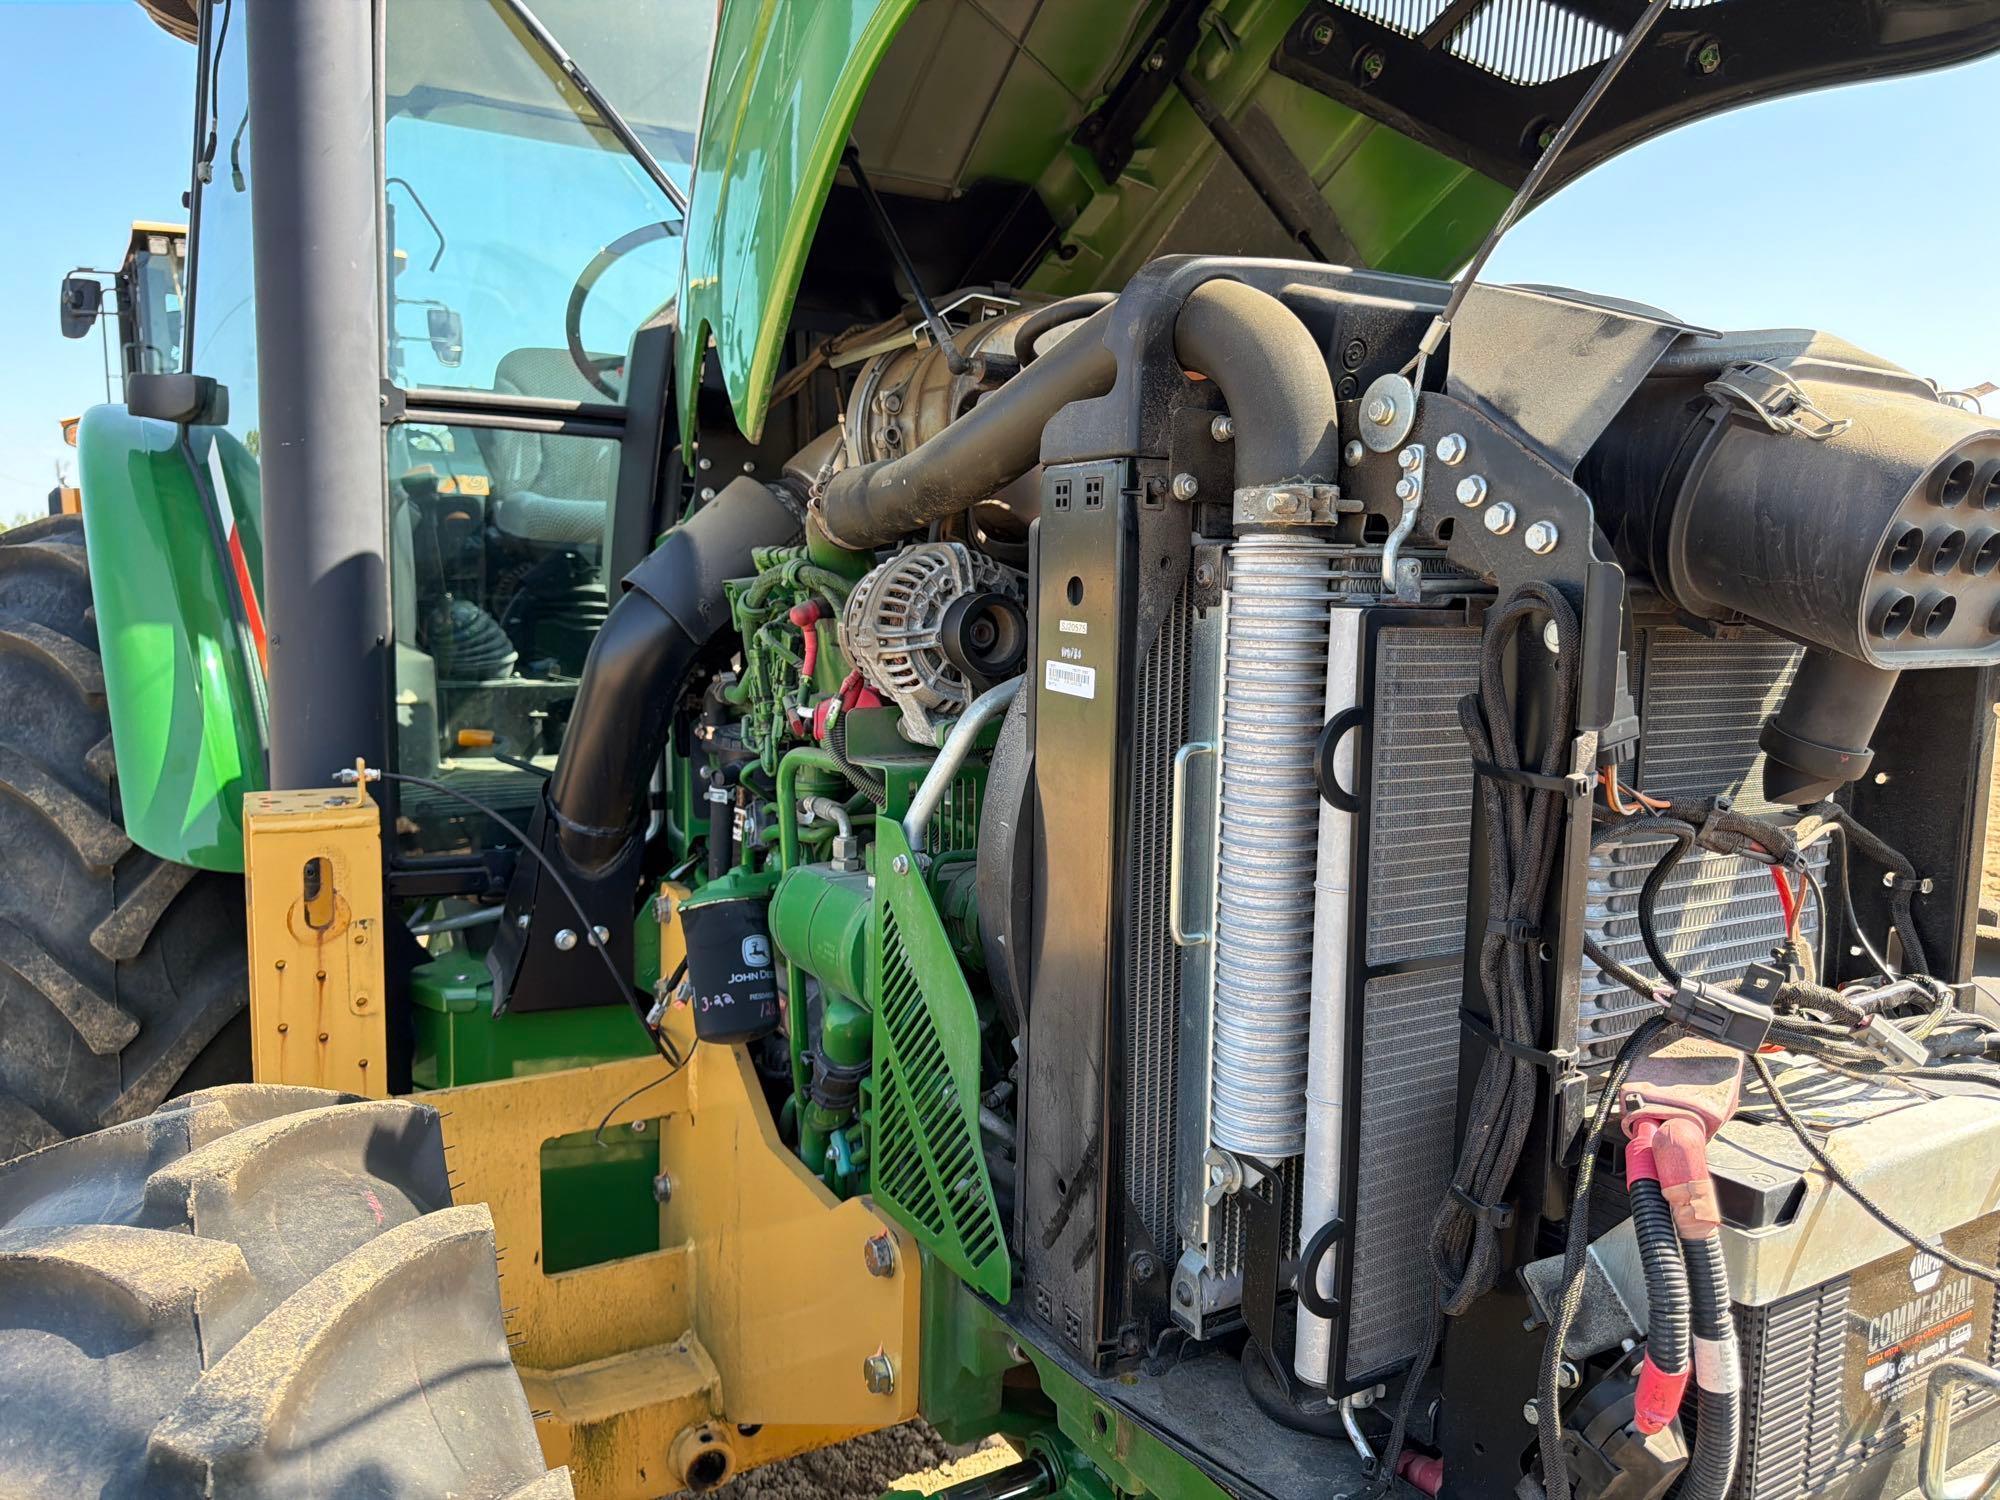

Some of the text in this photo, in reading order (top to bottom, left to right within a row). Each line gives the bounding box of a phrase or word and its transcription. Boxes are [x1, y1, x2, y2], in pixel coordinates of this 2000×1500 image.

[1061, 621, 1087, 633] SJ20575
[728, 971, 759, 984] JOHN
[701, 992, 735, 1012] 3.22
[1868, 1275, 1975, 1352] COMMERCIAL
